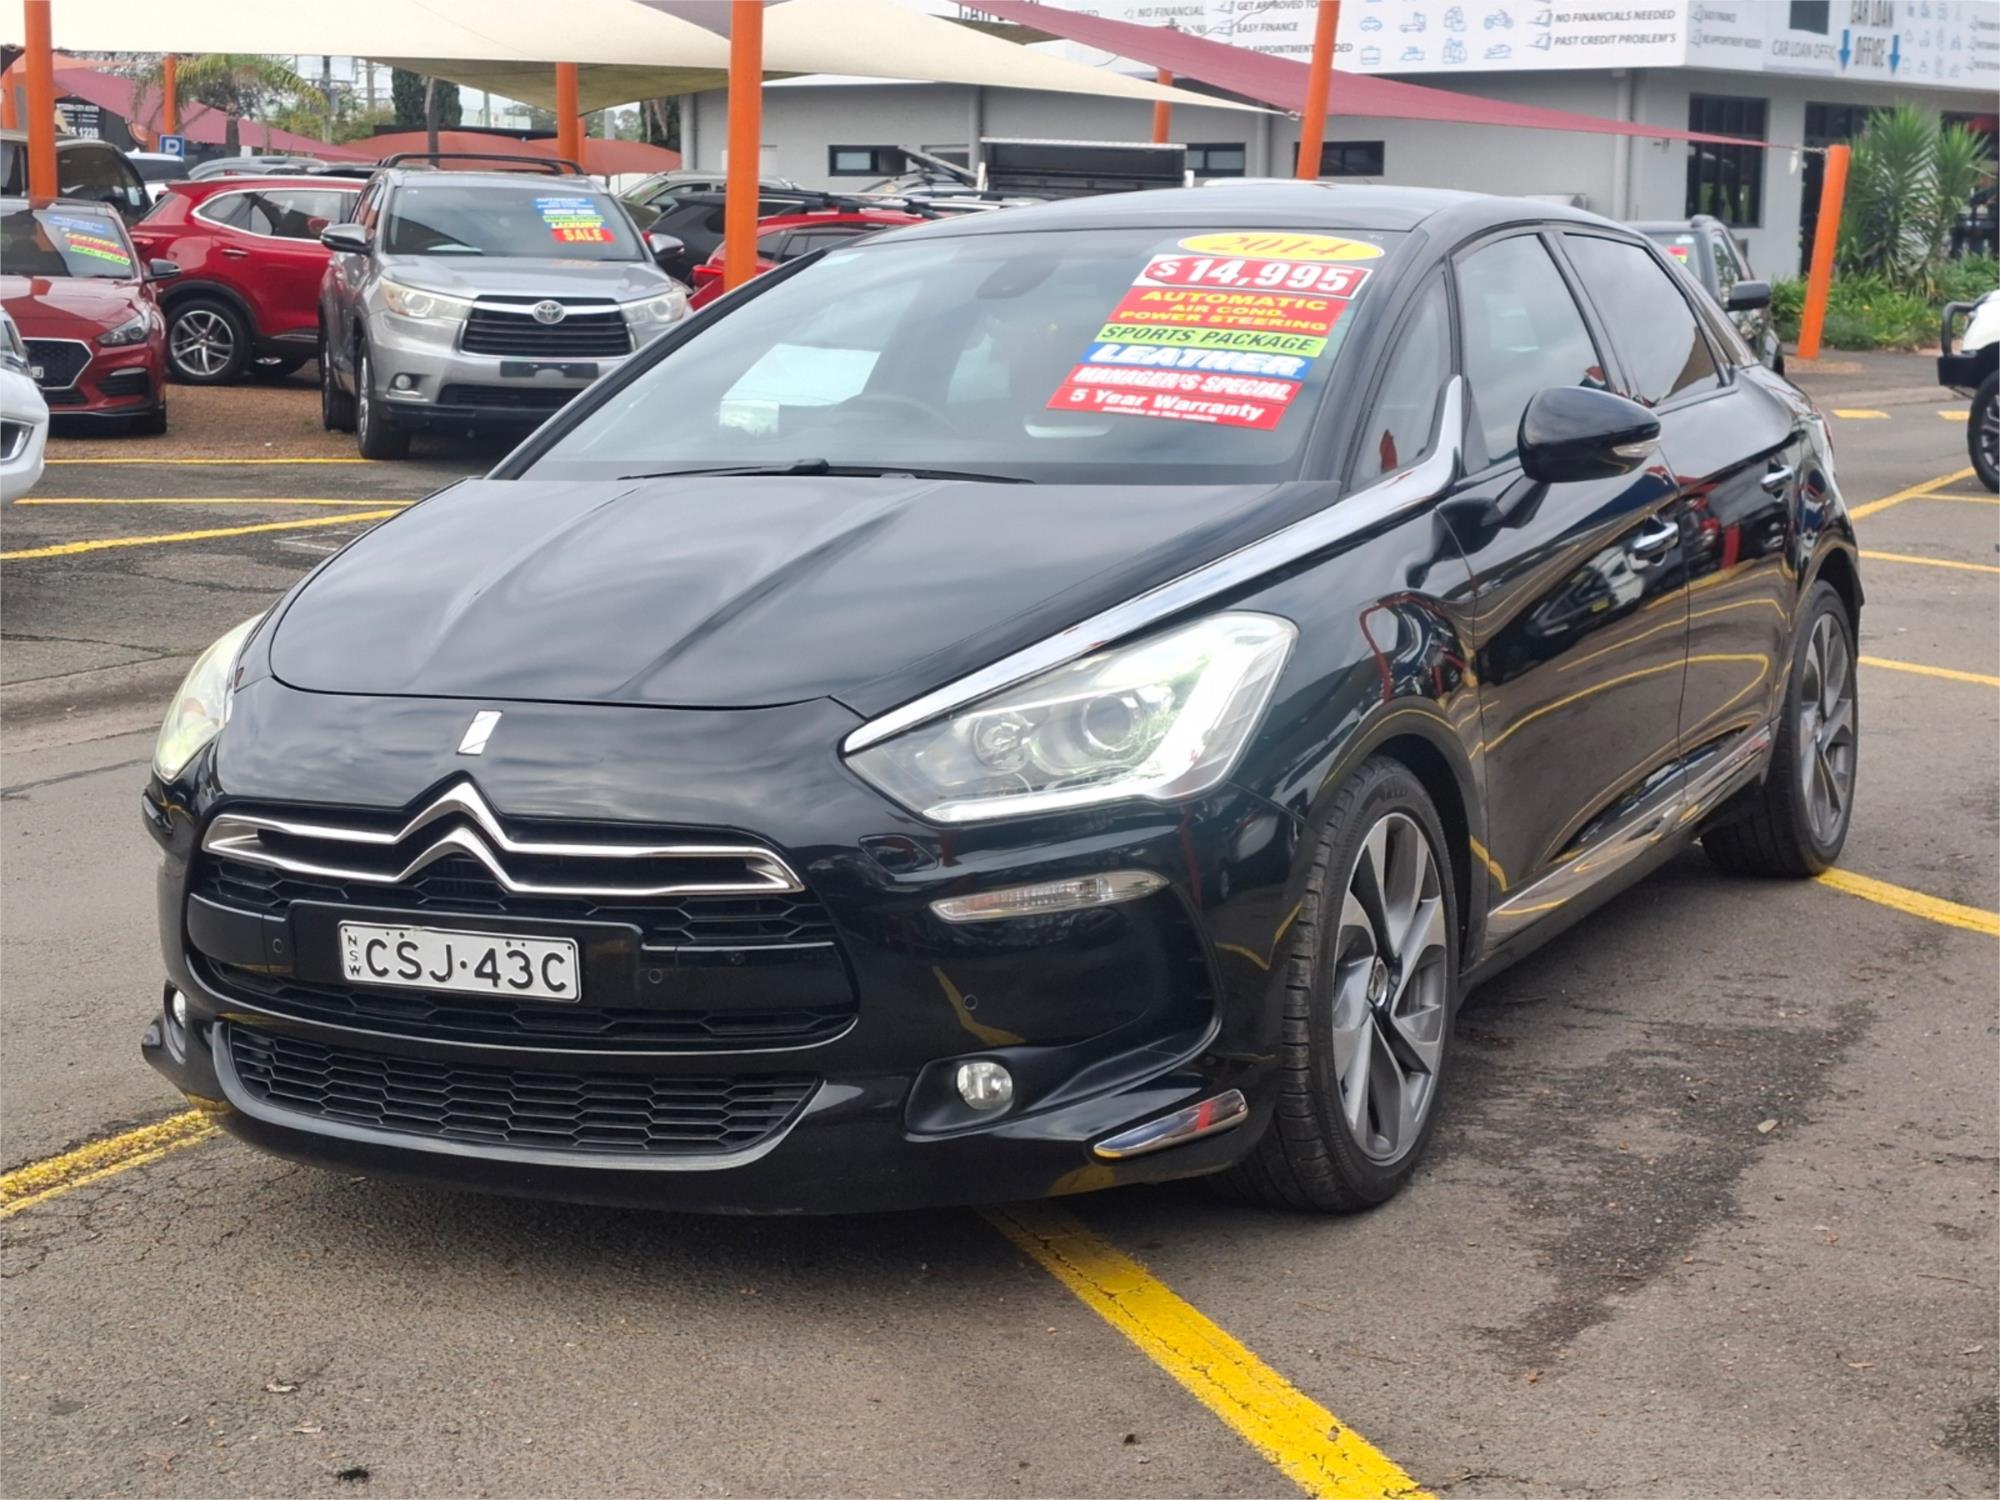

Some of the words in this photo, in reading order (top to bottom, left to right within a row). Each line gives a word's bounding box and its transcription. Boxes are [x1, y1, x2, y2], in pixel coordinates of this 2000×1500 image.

[1137, 8, 1152, 17] NO
[1555, 13, 1571, 23] NO
[1572, 11, 1633, 22] FINANCIALS
[1634, 10, 1676, 21] NEEDED
[1236, 23, 1258, 33] EASY
[1260, 22, 1299, 32] FINANCE
[1554, 36, 1579, 46] PAST
[1580, 35, 1617, 45] CREDIT
[1618, 33, 1677, 44] PROBLEM'S
[165, 139, 180, 154] P
[562, 229, 604, 241] SALE
[1210, 236, 1351, 257] 2014
[1141, 291, 1329, 311] AUTOMATIC
[1169, 304, 1209, 314] AIR
[1216, 305, 1288, 318] COND.
[1119, 310, 1203, 323] POWER
[1208, 315, 1328, 332] STEERING
[1102, 325, 1197, 342] SPORTS
[1200, 331, 1318, 351] PACKAGE
[1089, 343, 1306, 377] LEATHER
[1072, 366, 1203, 390] MANAGER'S
[1201, 375, 1292, 401] SPECIAL
[1069, 388, 1090, 402] 5
[1093, 390, 1148, 406] Year
[1152, 394, 1265, 422] Warranty
